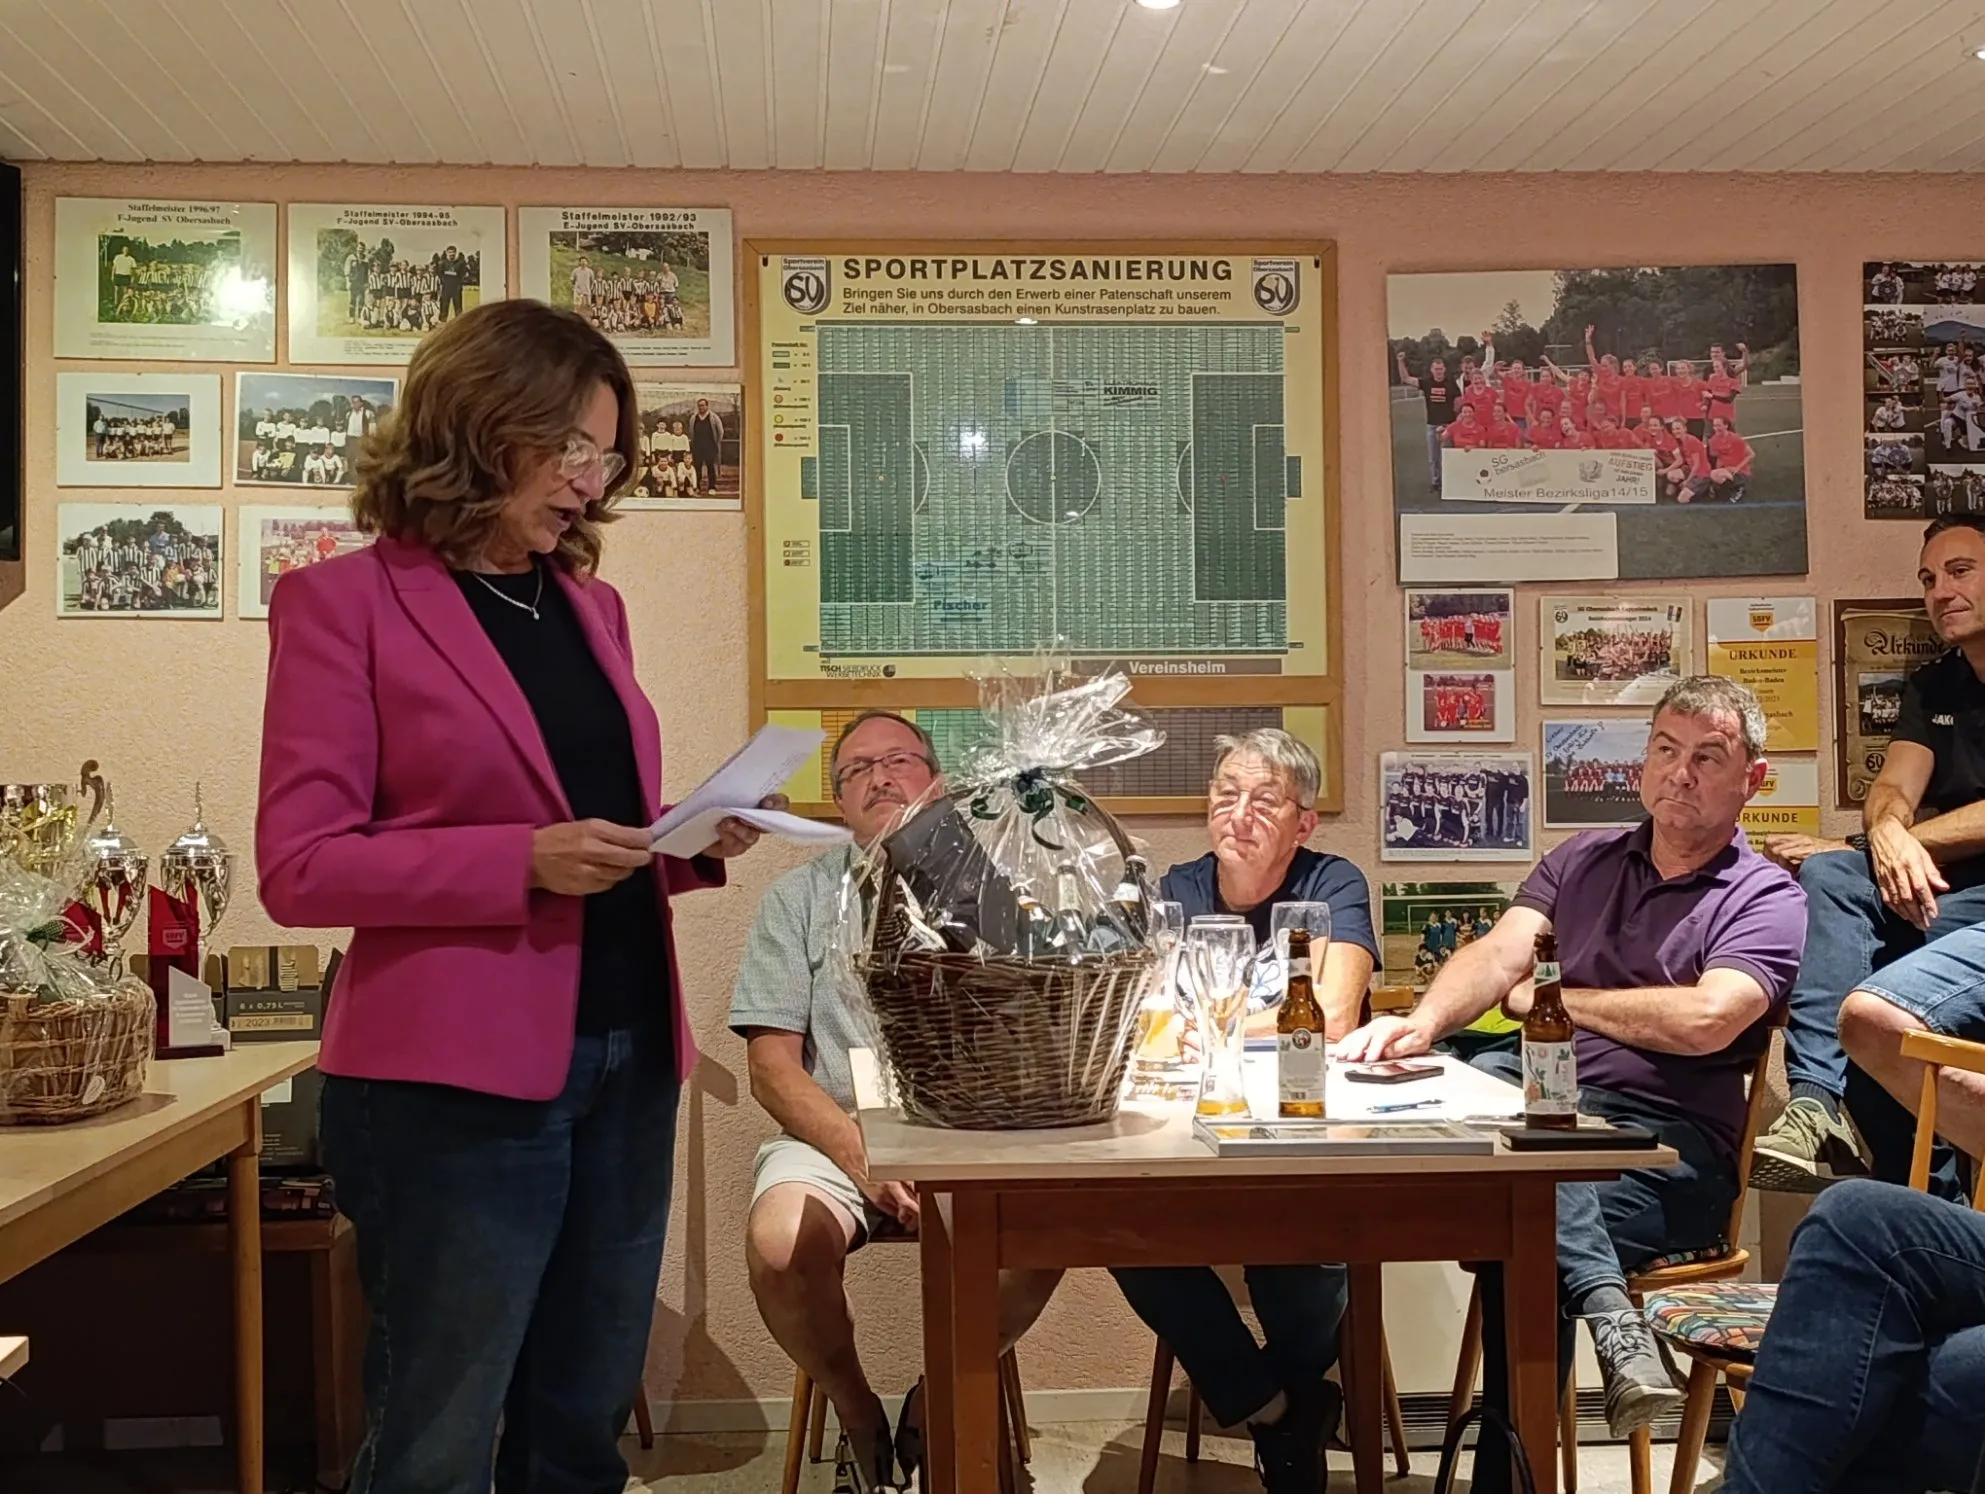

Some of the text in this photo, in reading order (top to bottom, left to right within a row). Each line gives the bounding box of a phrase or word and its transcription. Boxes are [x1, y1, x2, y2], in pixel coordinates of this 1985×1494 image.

[128, 204, 186, 213] Staffelmeister
[344, 210, 410, 218] Staffelmeister
[117, 214, 231, 225] F-Jugend SV Obersasbach
[336, 217, 458, 226] F-Jugend SV-Obersasbach
[561, 211, 697, 222] Staffelmeister 1992/93
[563, 222, 695, 231] E-Jugend SV-Obersasbach
[843, 258, 1232, 281] SPORTPLATZSANIERUNG
[843, 287, 1232, 302] Bringen Sie uns durch den Erwerb einer Patenschaft unserem
[843, 302, 1220, 317] Ziel näher, in Obersasbach einen Kunstrasenplatz zu bauen.
[1104, 386, 1158, 396] KIMMIG
[1491, 454, 1508, 468] SG
[1607, 457, 1654, 472] AUFSTIEG
[1484, 486, 1649, 500] Meister Bezirksliga 14/15
[1729, 648, 1797, 660] URKUNDE
[1128, 660, 1226, 674] Vereinsheim
